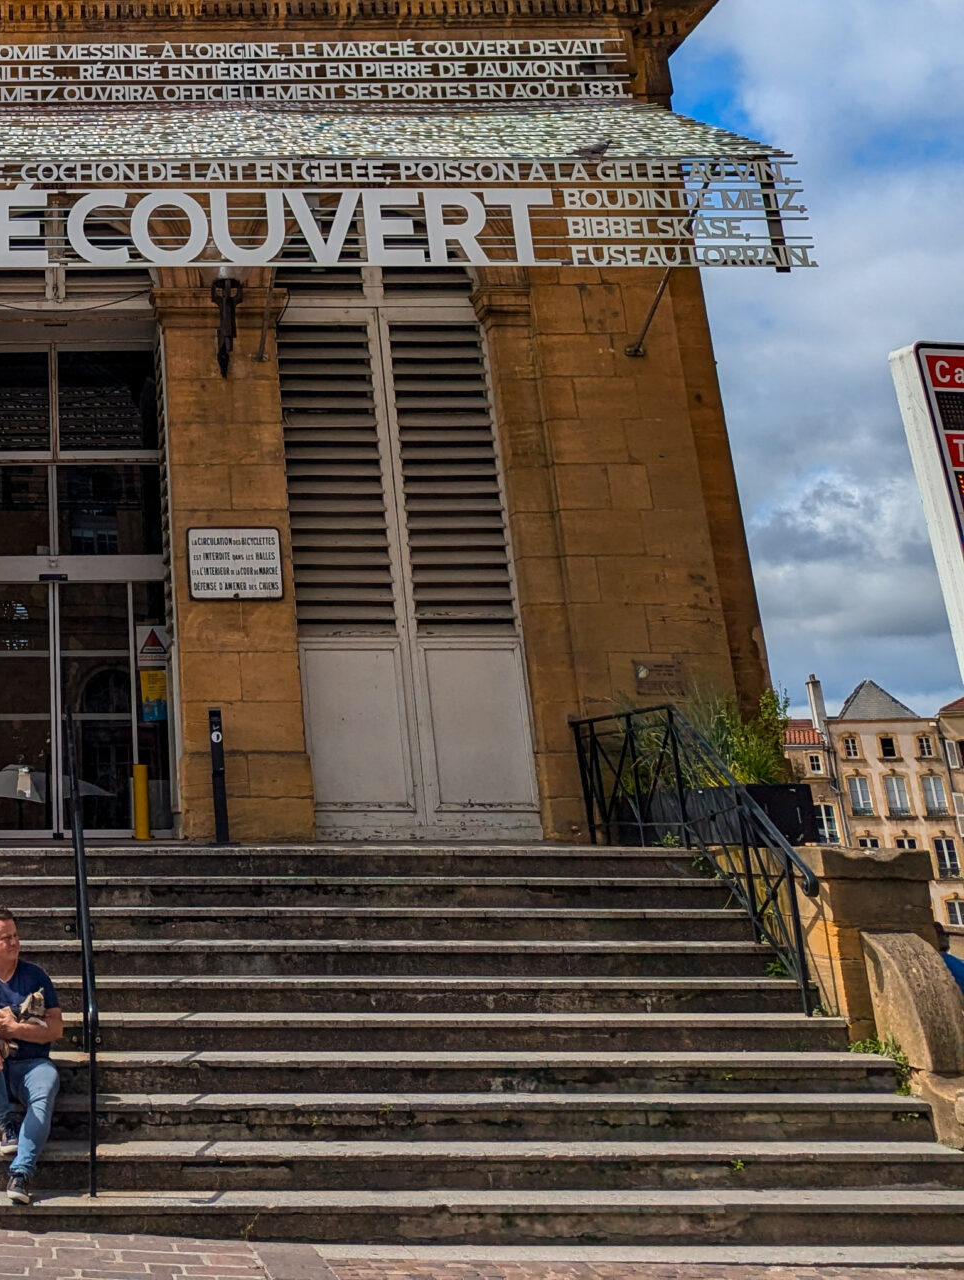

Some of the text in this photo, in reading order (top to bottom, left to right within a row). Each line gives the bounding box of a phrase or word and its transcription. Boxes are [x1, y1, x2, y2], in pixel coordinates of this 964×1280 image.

[57, 43, 154, 60] MESSINE.
[161, 41, 176, 59] À
[182, 42, 285, 60] L'ORIGINE,
[293, 41, 316, 58] LE
[323, 39, 416, 58] MARCHÉ
[421, 40, 524, 57] COUVERT
[529, 39, 605, 56] DEVAIT
[79, 62, 162, 80] RÉALISÉ
[168, 62, 321, 80] ENTIÈREMENT
[326, 62, 356, 78] EN
[362, 62, 433, 78] PIERRE
[438, 61, 466, 77] DE
[471, 60, 584, 77] JAUMONT.
[1, 86, 58, 102] METZ
[63, 86, 158, 102] OUVRIRA
[163, 84, 340, 101] OFFICIELLEMENT
[344, 84, 383, 100] SES
[389, 83, 471, 99] PORTES
[476, 83, 506, 98] EN
[513, 80, 574, 98] AOÛT
[579, 81, 633, 98] 1831.
[21, 163, 140, 182] COCHON
[148, 162, 182, 182] DE
[190, 162, 248, 182] LAIT
[255, 161, 293, 181] EN
[301, 158, 391, 184] GELÉE,
[399, 161, 519, 181] POISSON
[528, 159, 547, 181] À
[554, 161, 590, 181] LA
[597, 159, 681, 181] GELÉE
[688, 161, 725, 182] AU
[732, 161, 790, 185] VIN,
[562, 189, 806, 213] BOUDIN DE METZ,
[67, 188, 553, 267] COUVERT
[567, 214, 751, 241] BIBBELSKÄSE,
[571, 245, 817, 267] FUSEAU LORRAIN.
[197, 537, 232, 545] CIRCULATION
[241, 537, 276, 545] BICYCLETTES
[203, 552, 230, 560] INTERDITE
[255, 552, 275, 560] HALLES
[241, 567, 253, 575] COUR
[259, 582, 279, 590] CHIENS
